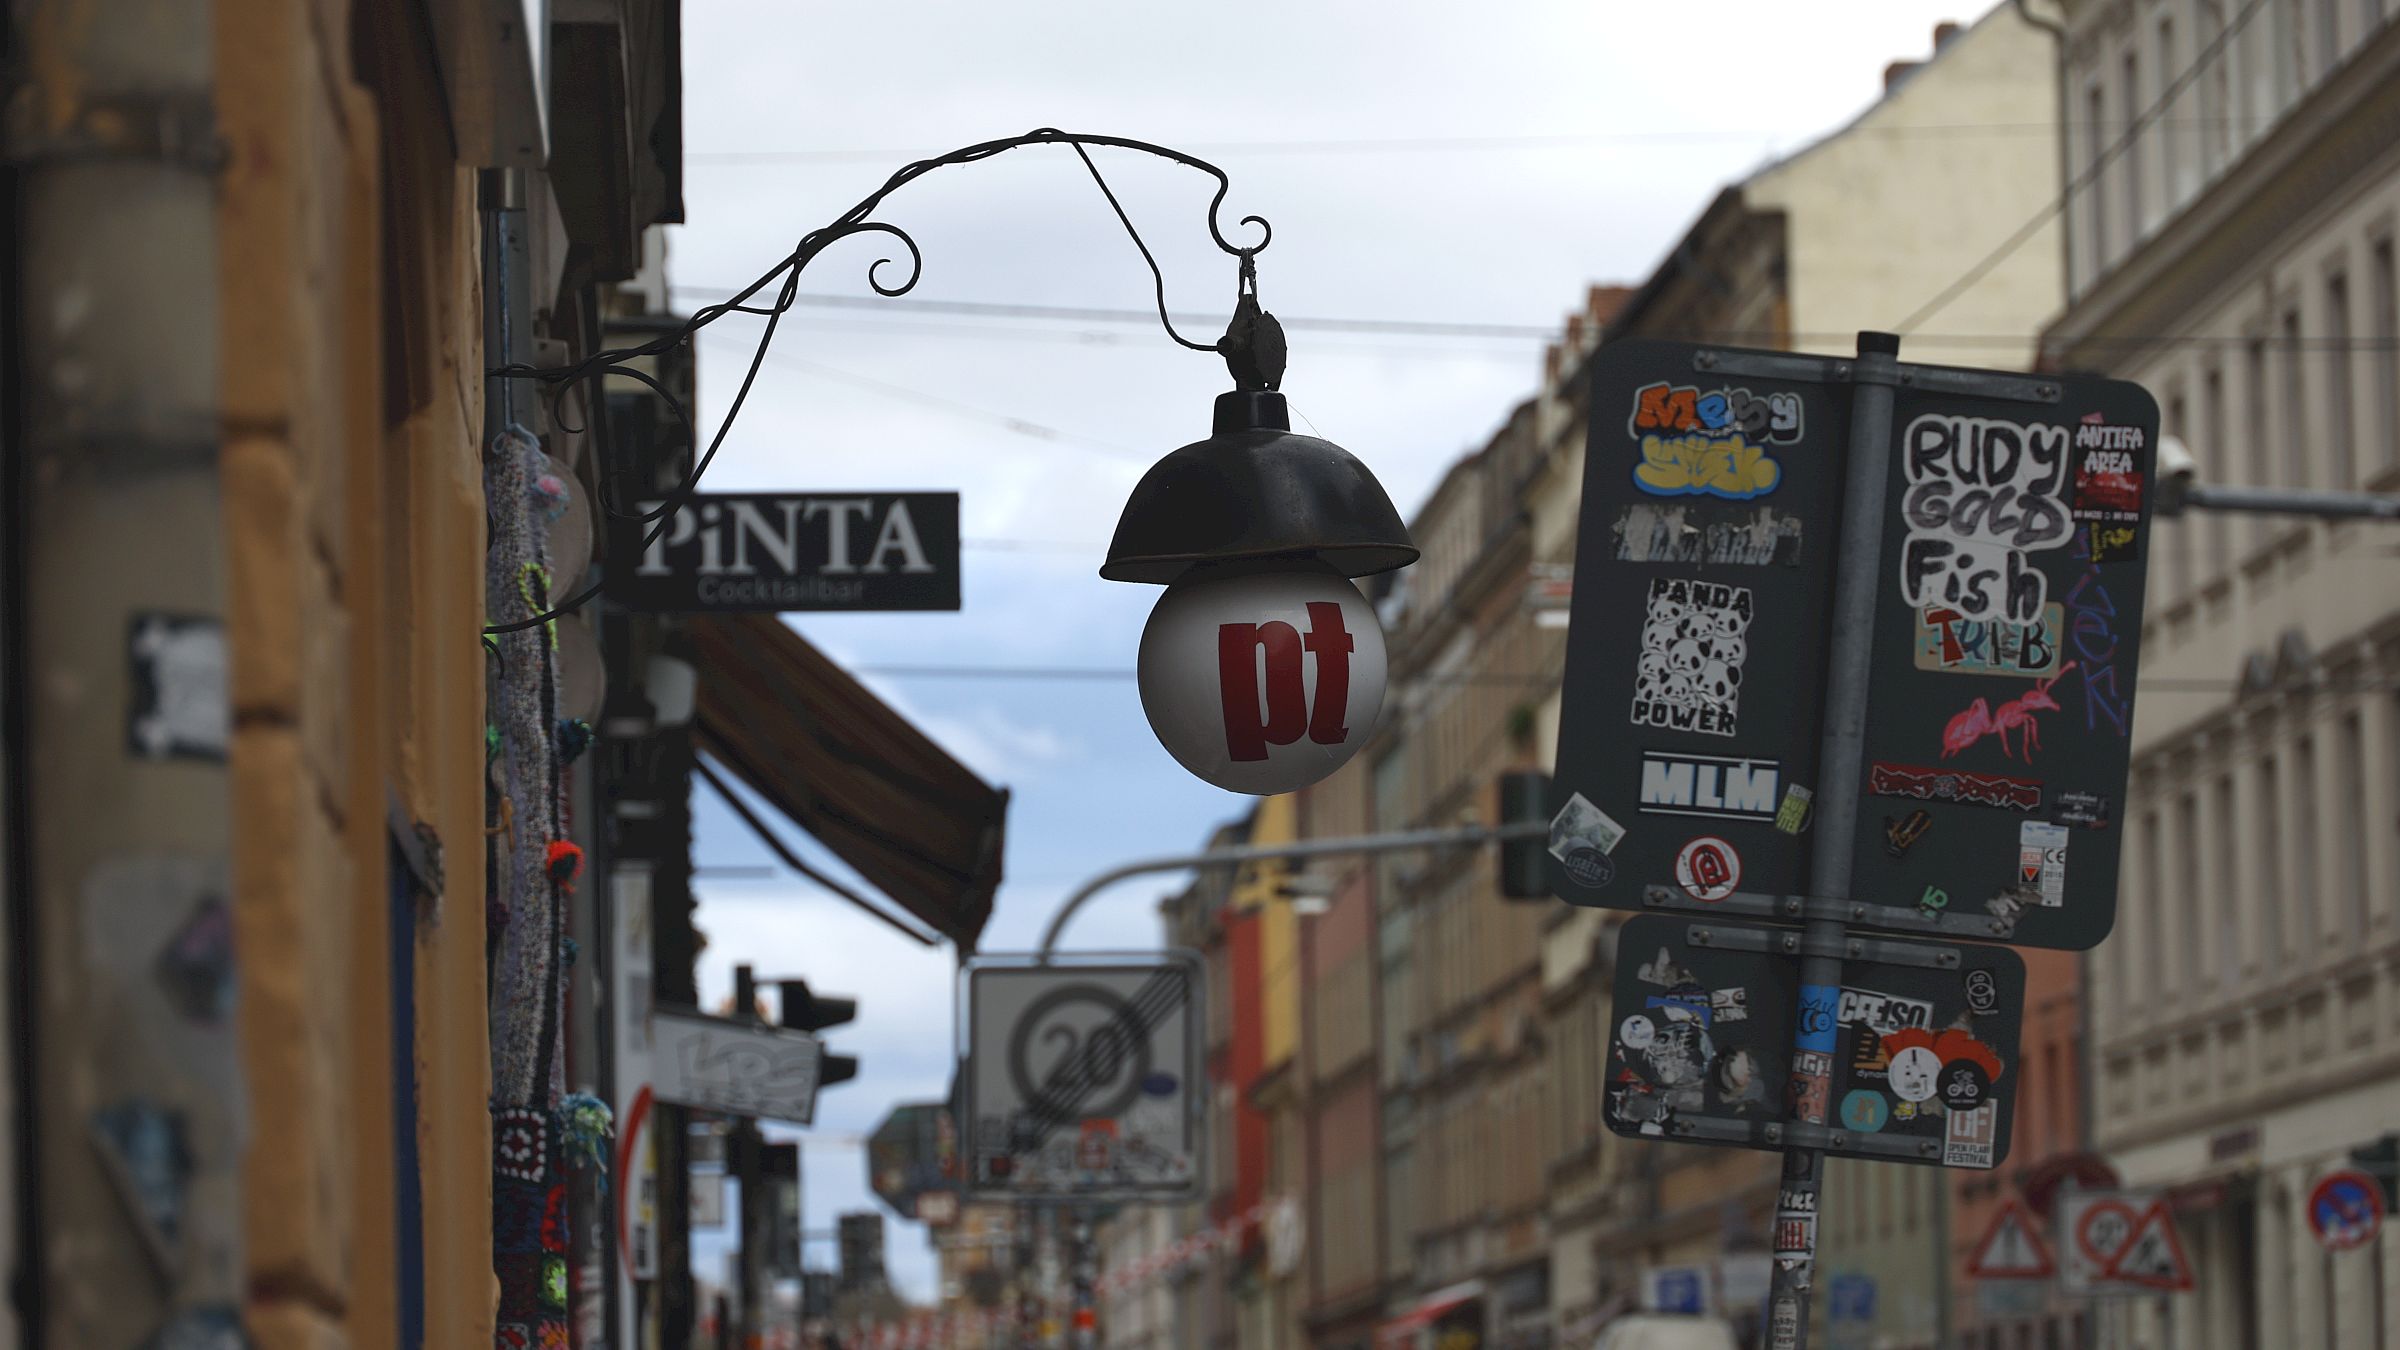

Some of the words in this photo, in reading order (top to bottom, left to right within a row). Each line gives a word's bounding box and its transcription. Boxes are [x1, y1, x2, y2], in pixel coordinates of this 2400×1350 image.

[1911, 420, 2065, 496] RUDY
[2075, 424, 2145, 450] ANTIFA
[2083, 450, 2134, 474] AREA
[634, 497, 937, 577] PiNTA
[1910, 480, 2066, 547] GOLD
[697, 575, 865, 605] Cocktailbar
[1652, 578, 1751, 614] PANDA
[1906, 538, 2041, 621] Fish
[1218, 601, 1355, 762] pt
[1634, 700, 1738, 734] POWER
[1640, 759, 1779, 813] MLM
[1042, 1022, 1122, 1087] 20
[1946, 1152, 1990, 1165] FESTIVAL
